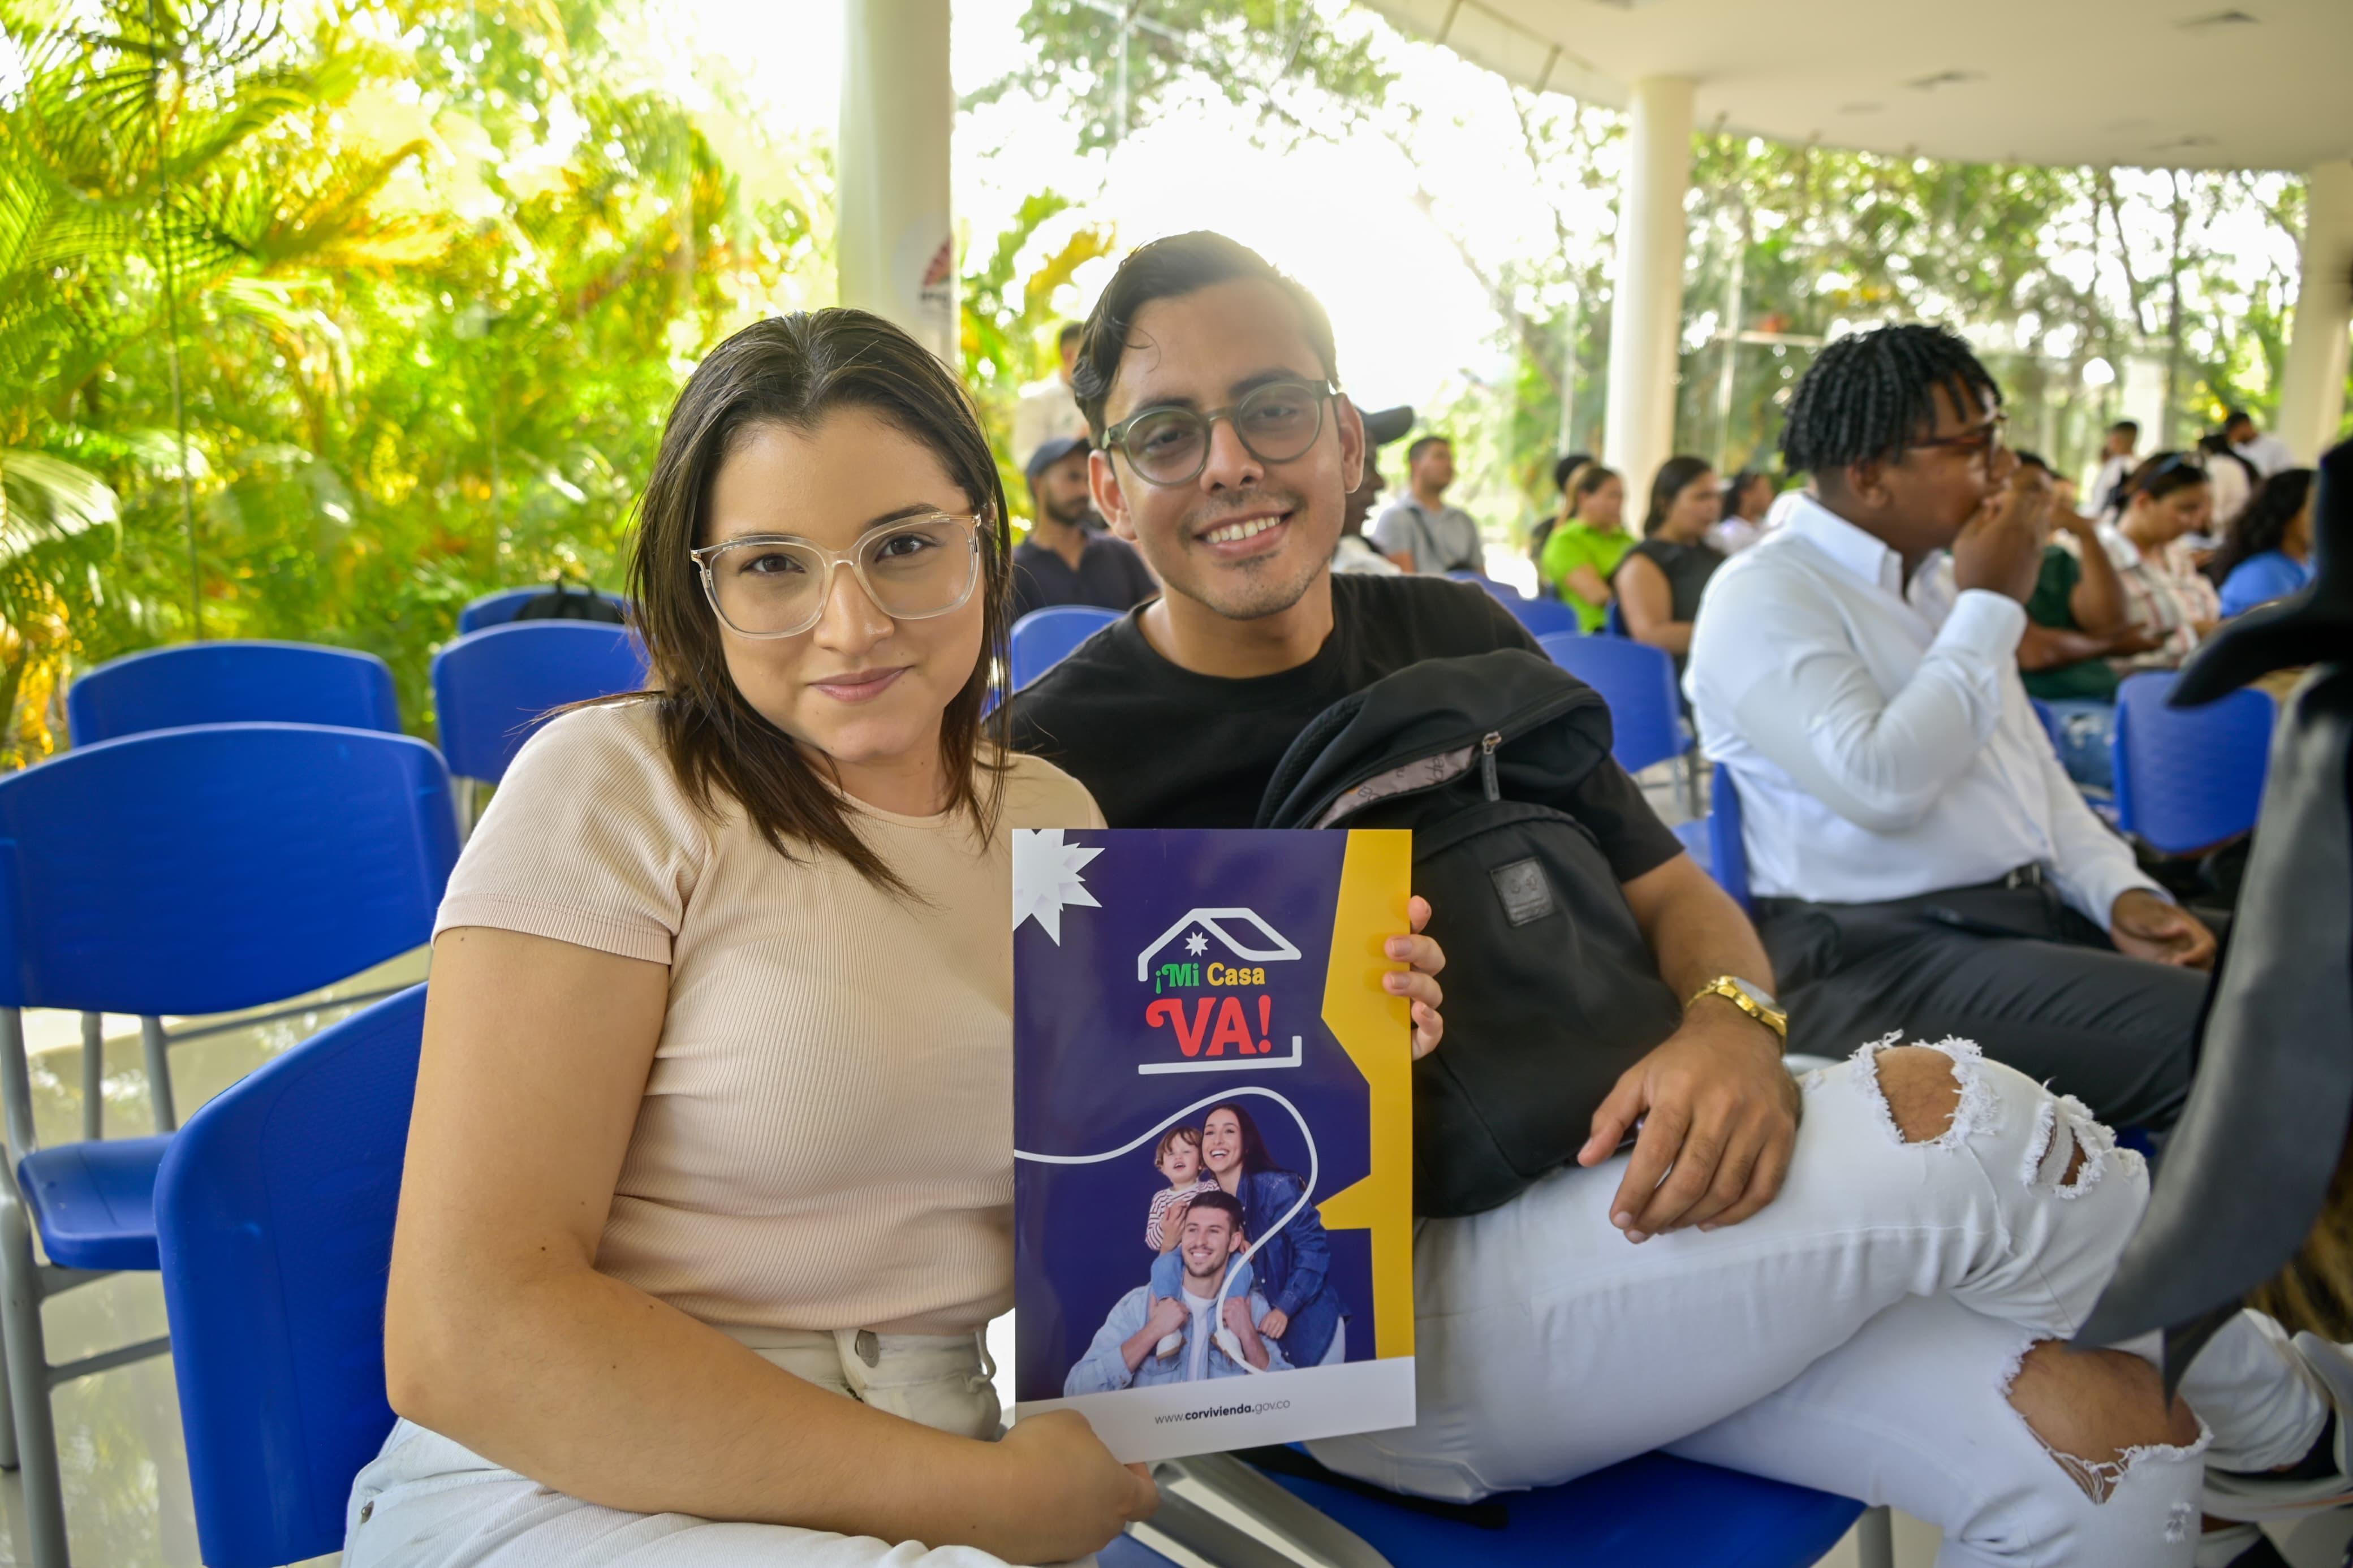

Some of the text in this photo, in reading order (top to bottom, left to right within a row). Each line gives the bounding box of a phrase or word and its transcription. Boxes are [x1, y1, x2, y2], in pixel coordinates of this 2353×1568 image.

[1156, 962, 1266, 994] ¡Mi Casa
[1146, 995, 1272, 1057] VA!
[1154, 1399, 1291, 1424] www.corvivienda.gov.co
